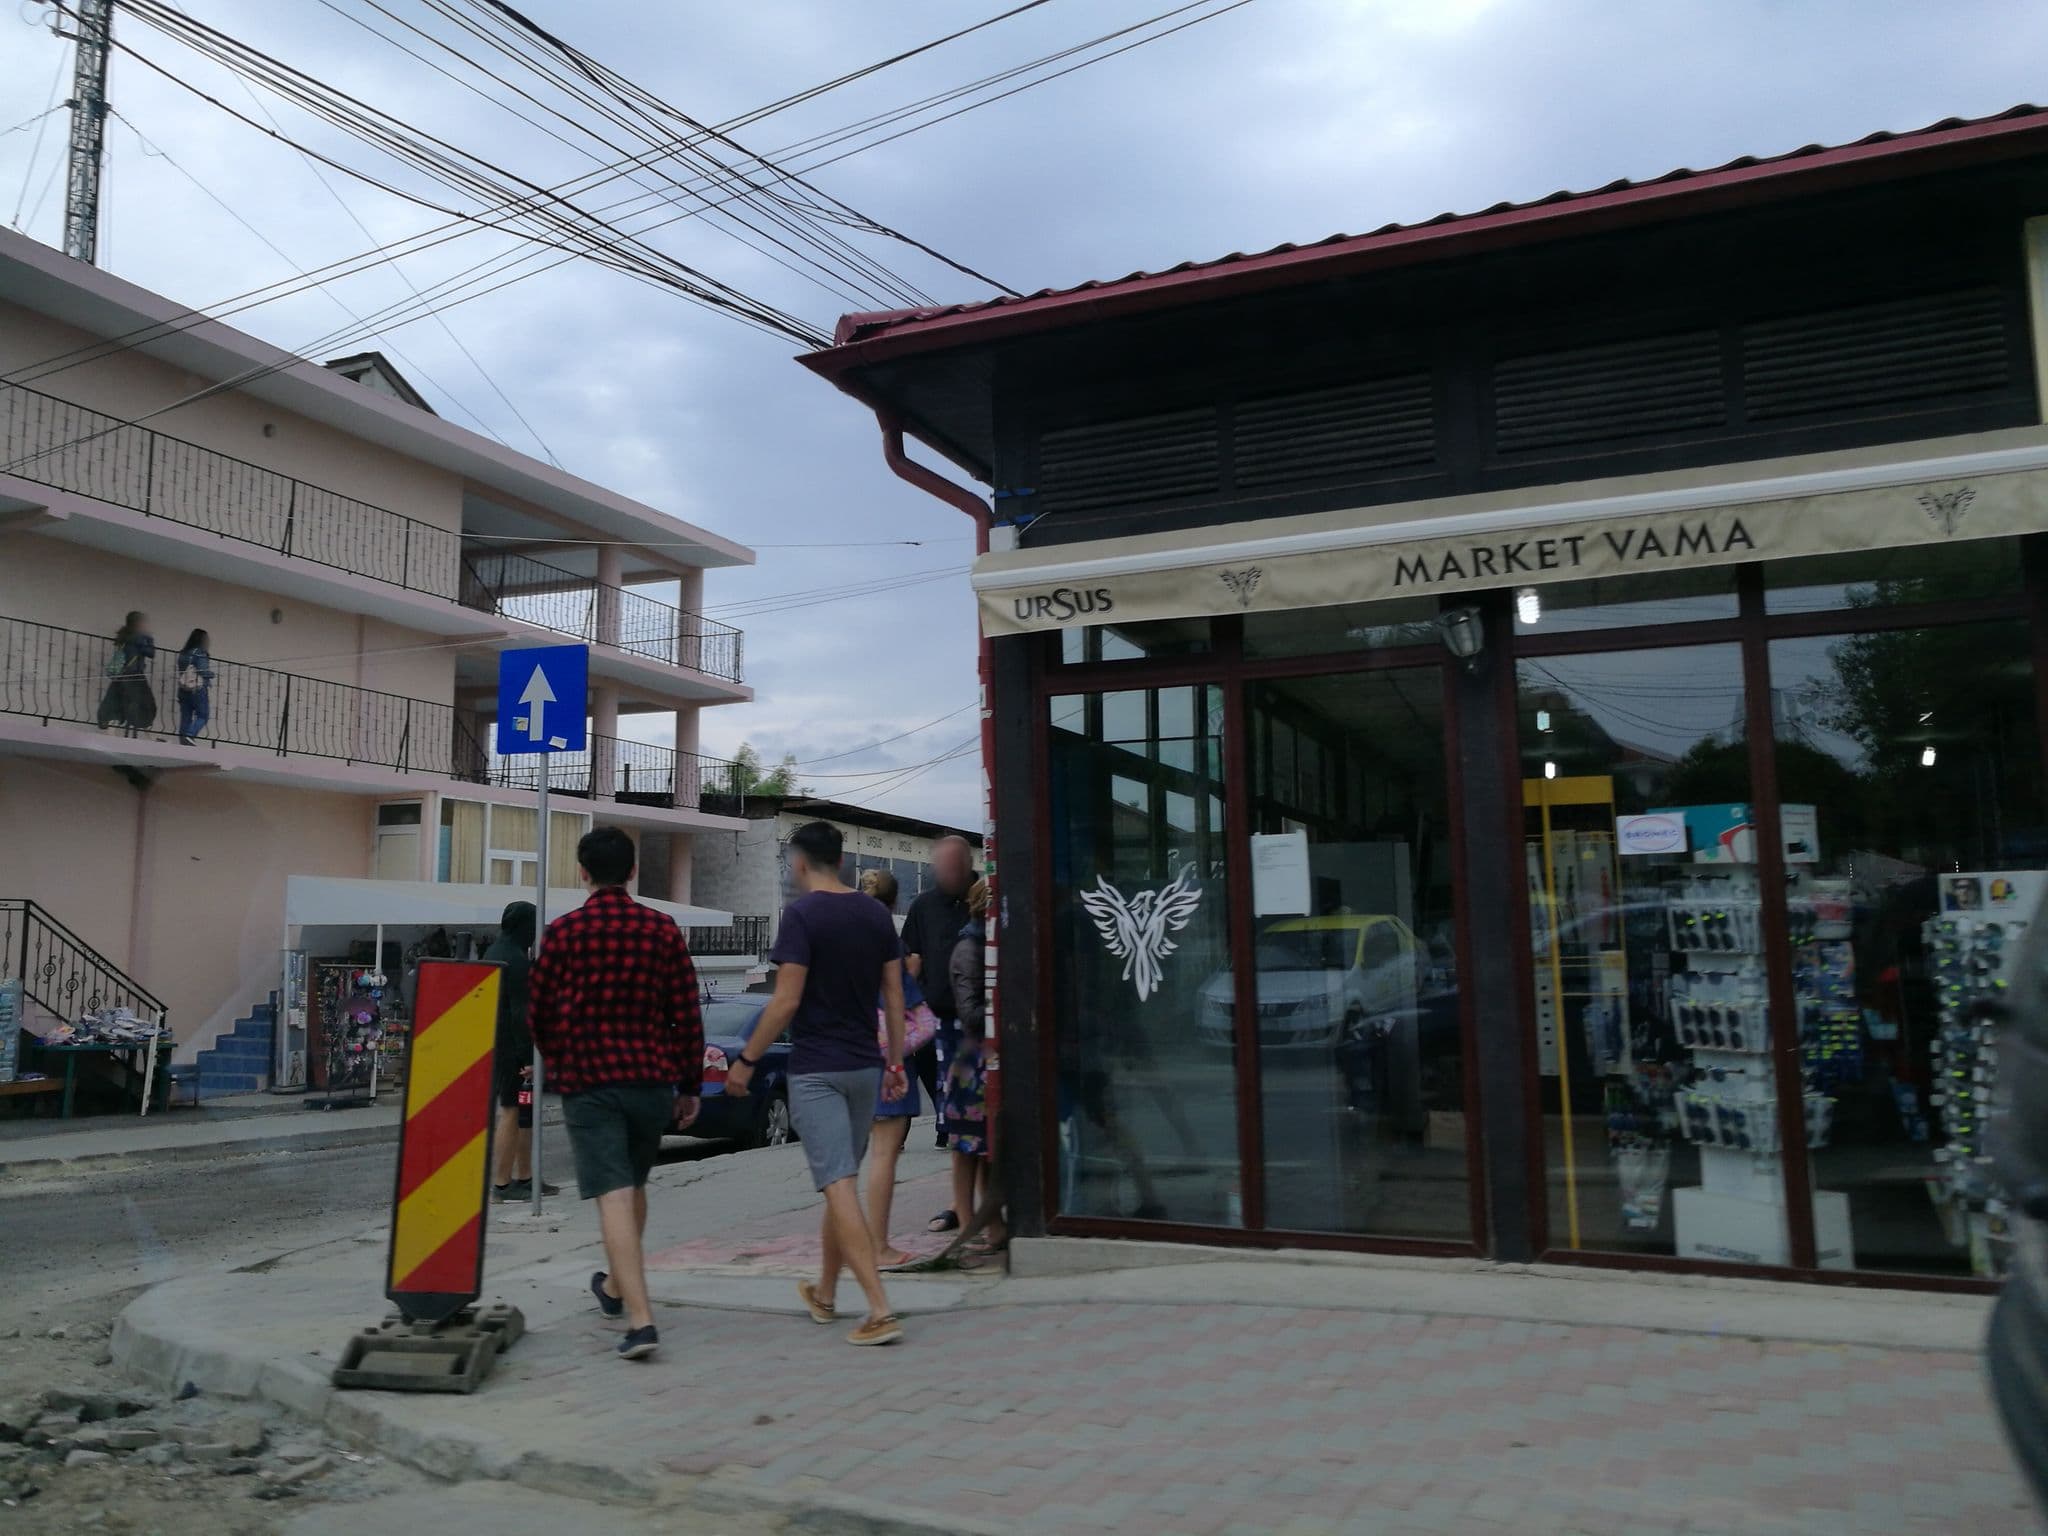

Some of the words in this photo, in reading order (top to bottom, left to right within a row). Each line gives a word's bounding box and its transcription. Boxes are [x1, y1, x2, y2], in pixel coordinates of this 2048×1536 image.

[1393, 535, 1585, 586] MARKET
[1604, 517, 1756, 561] VAMA
[1014, 588, 1113, 621] URSUS
